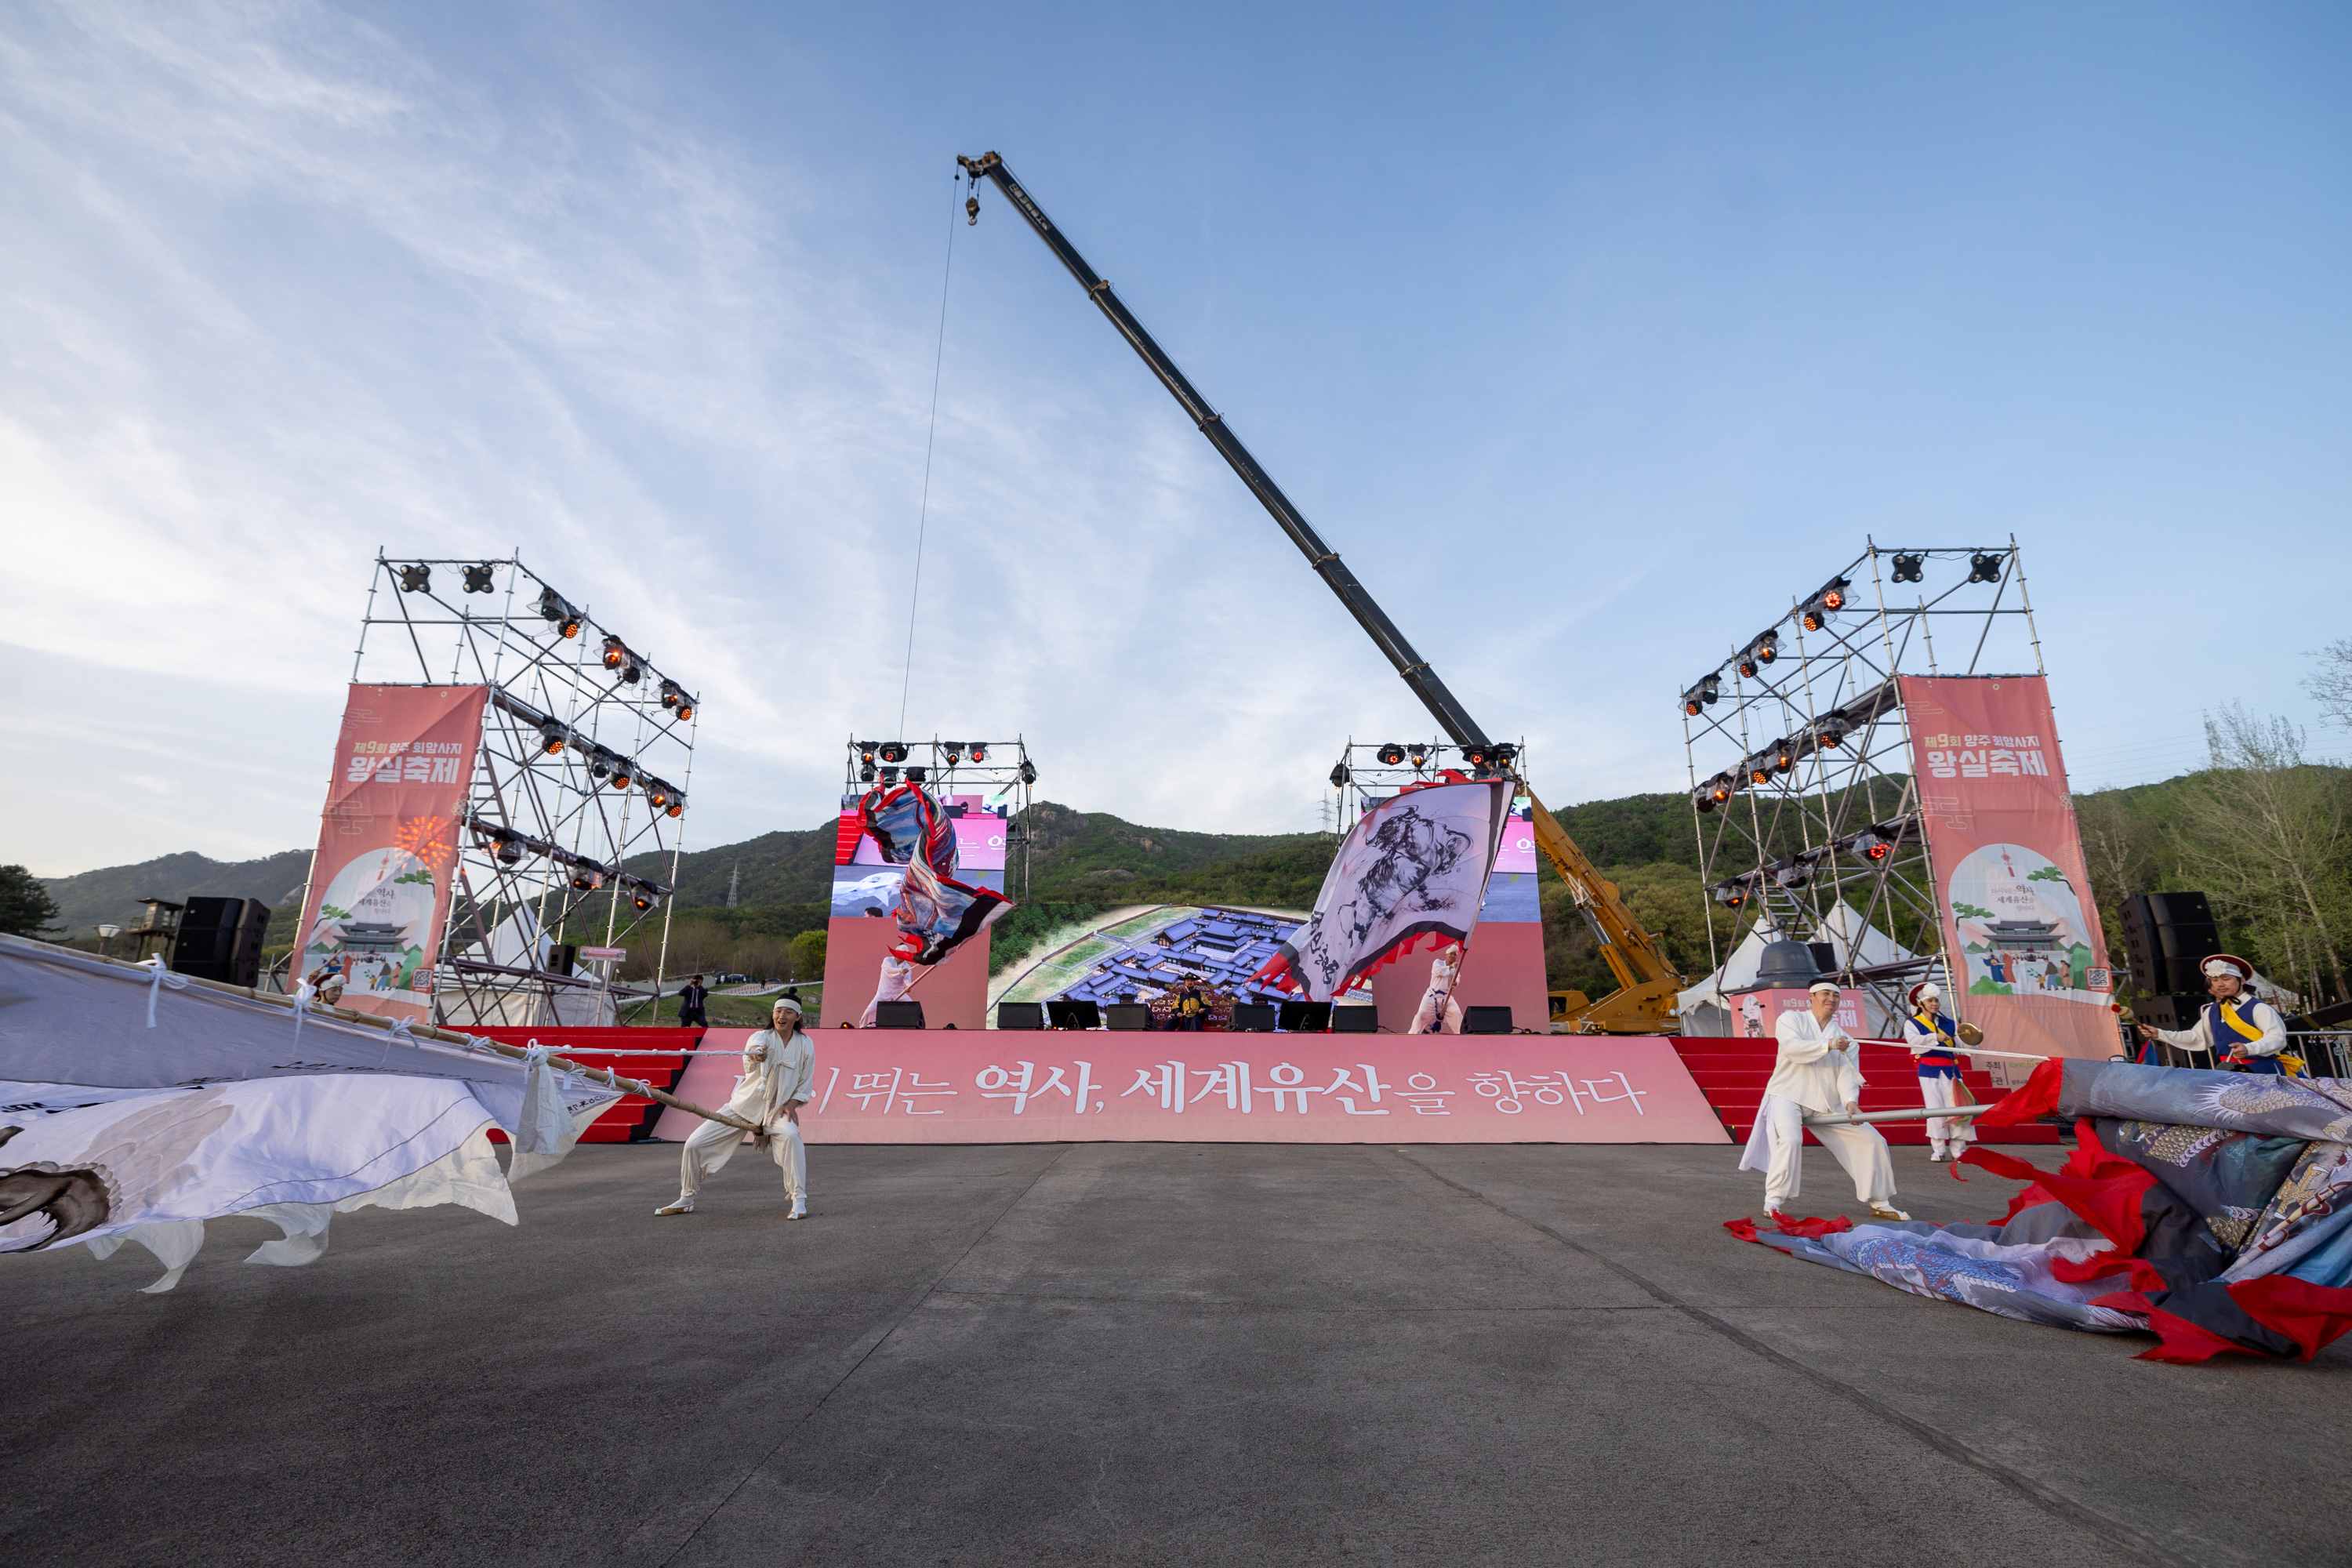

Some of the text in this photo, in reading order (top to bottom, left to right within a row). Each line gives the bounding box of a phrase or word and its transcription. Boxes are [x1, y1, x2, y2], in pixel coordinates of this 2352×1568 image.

[354, 741, 462, 754] 제9회 양주 회암사지
[1924, 734, 2040, 747] 제9회 양주 회암사지
[347, 756, 460, 784] 왕실축제
[1927, 749, 2049, 778] 왕실축제
[846, 1067, 957, 1115] 뛰는
[975, 1061, 1102, 1115] 역사,
[1120, 1060, 1454, 1116] 세계유산을
[1466, 1070, 1647, 1116] 향하다
